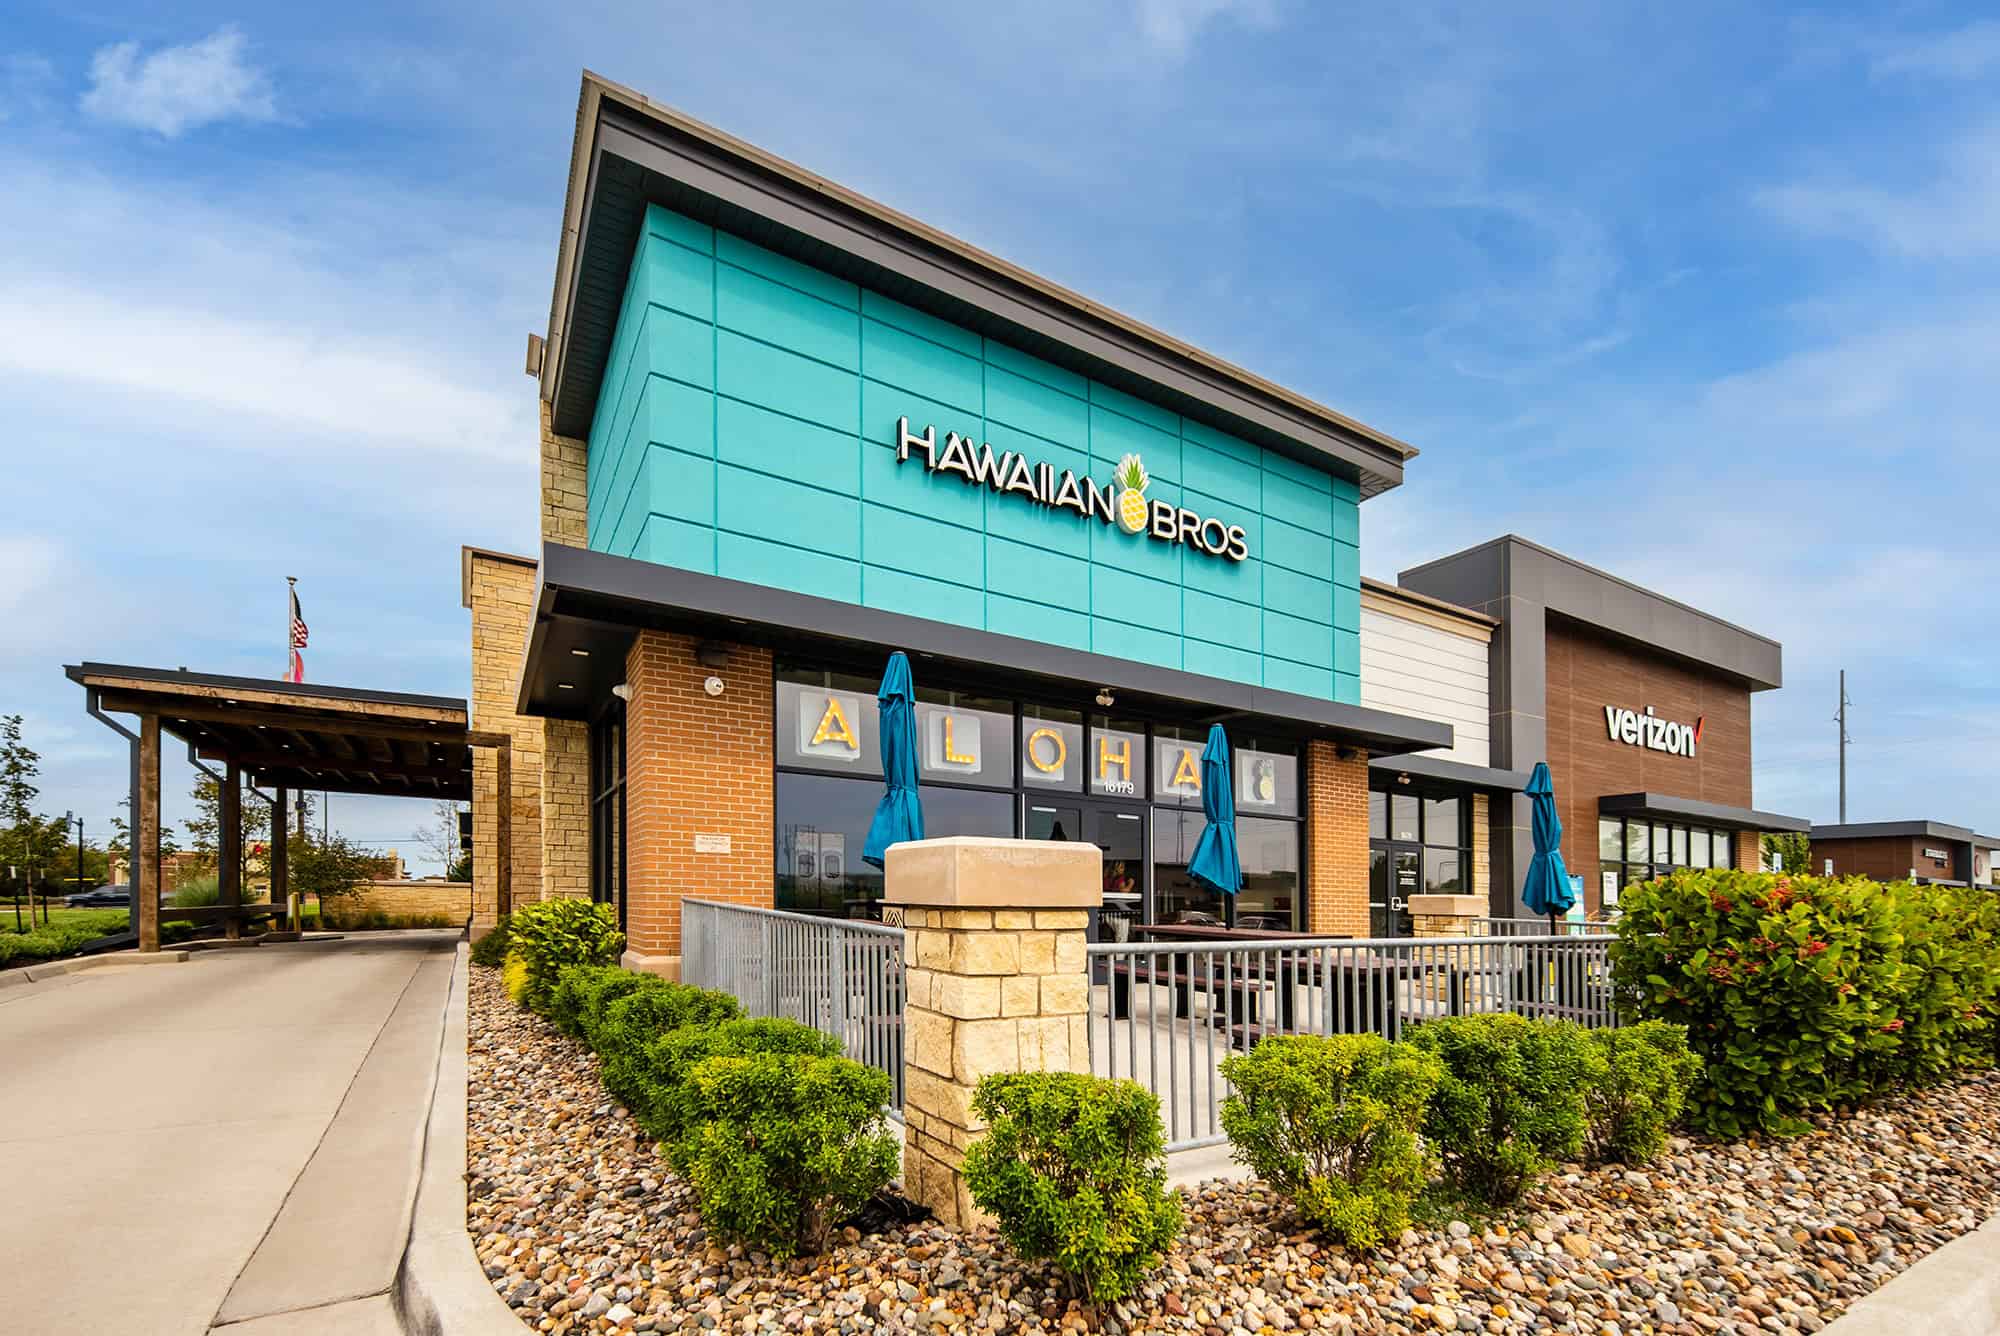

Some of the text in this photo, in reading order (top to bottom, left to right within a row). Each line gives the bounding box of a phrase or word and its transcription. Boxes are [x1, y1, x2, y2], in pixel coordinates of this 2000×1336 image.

[896, 415, 1249, 562] HAWAIIAN BROS
[1604, 705, 1696, 758] verizon
